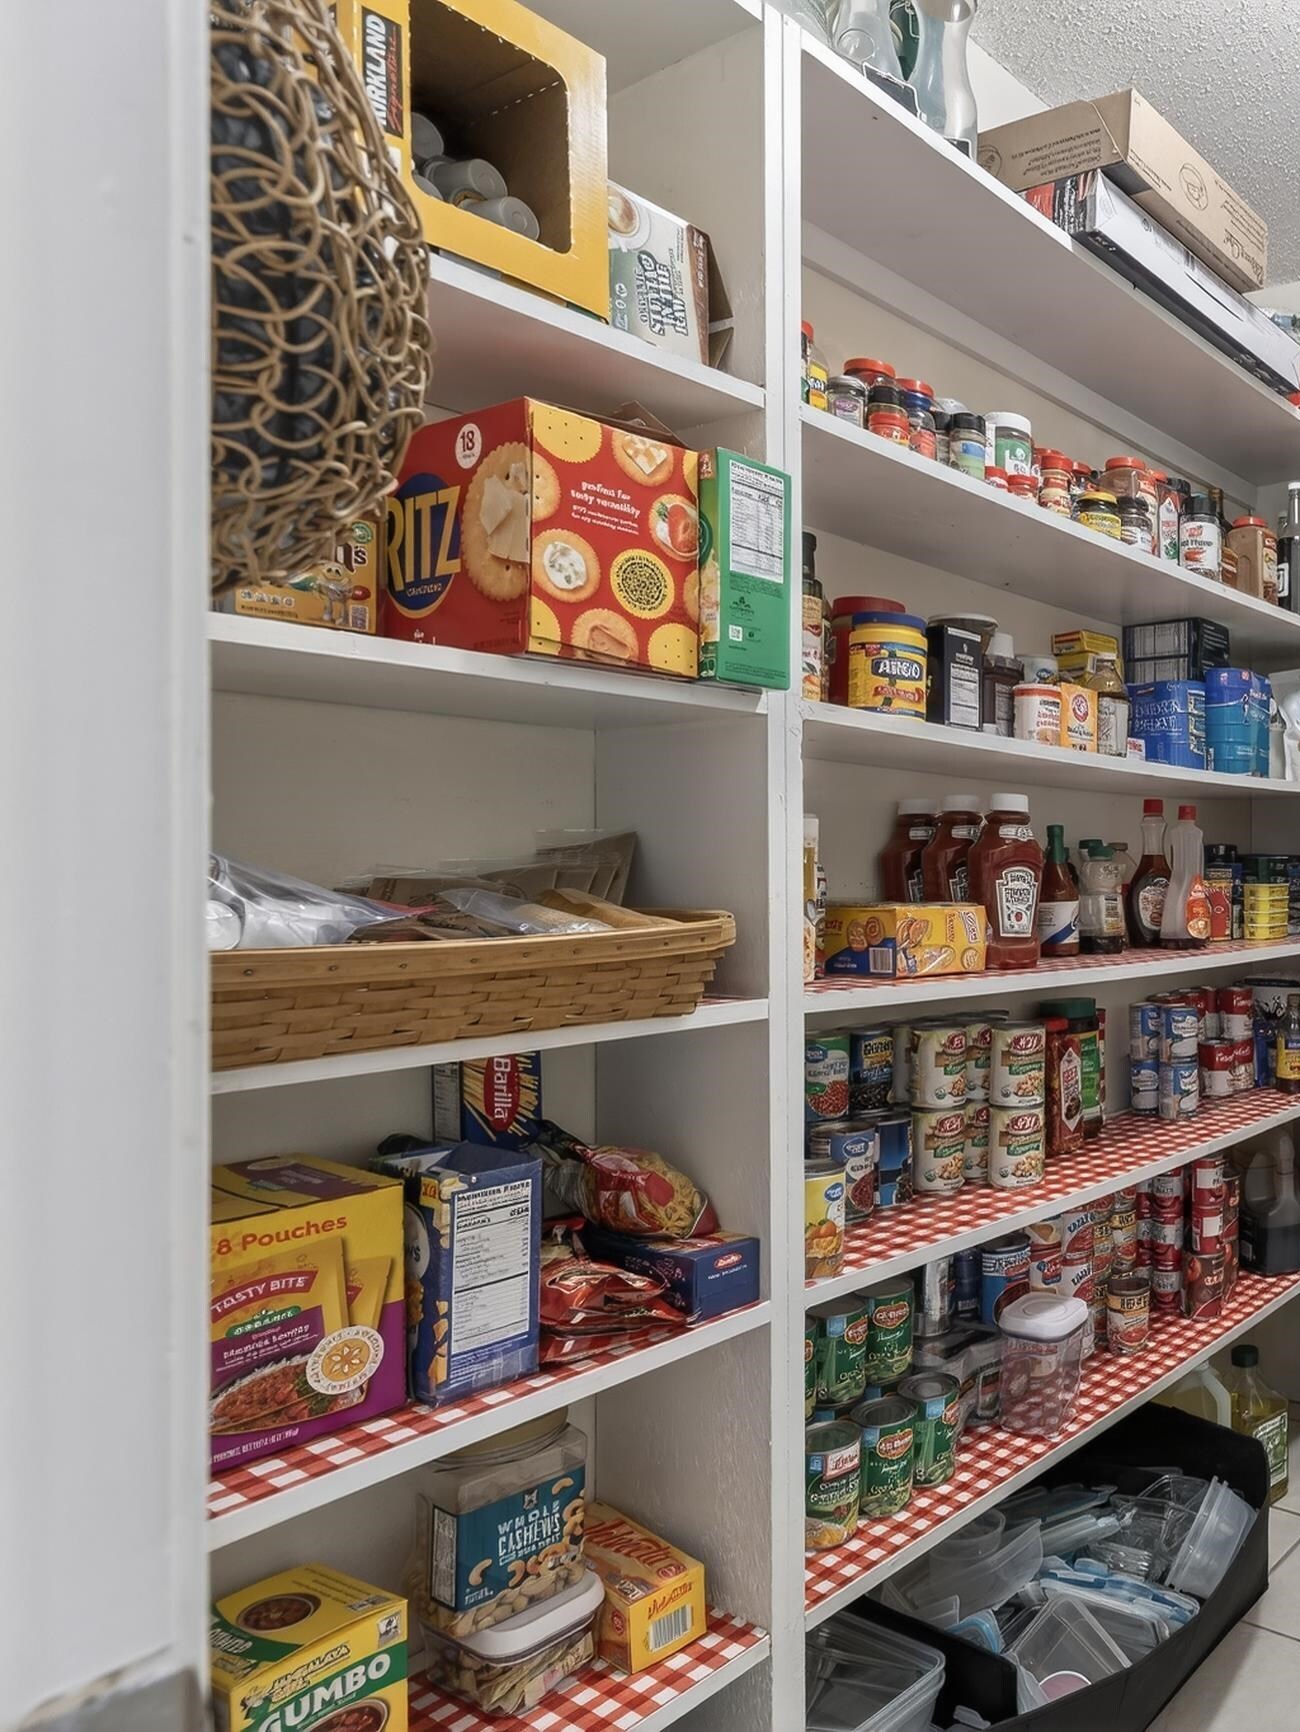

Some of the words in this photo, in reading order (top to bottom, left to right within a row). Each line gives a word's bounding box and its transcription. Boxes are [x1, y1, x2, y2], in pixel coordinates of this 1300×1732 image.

[460, 430, 475, 452] 18
[387, 485, 462, 592] RITZ
[493, 1057, 512, 1121] Barilla
[216, 1238, 233, 1256] 8
[241, 1216, 348, 1251] Pouches
[270, 1275, 309, 1292] BITE
[498, 1513, 561, 1557] CASHEWS
